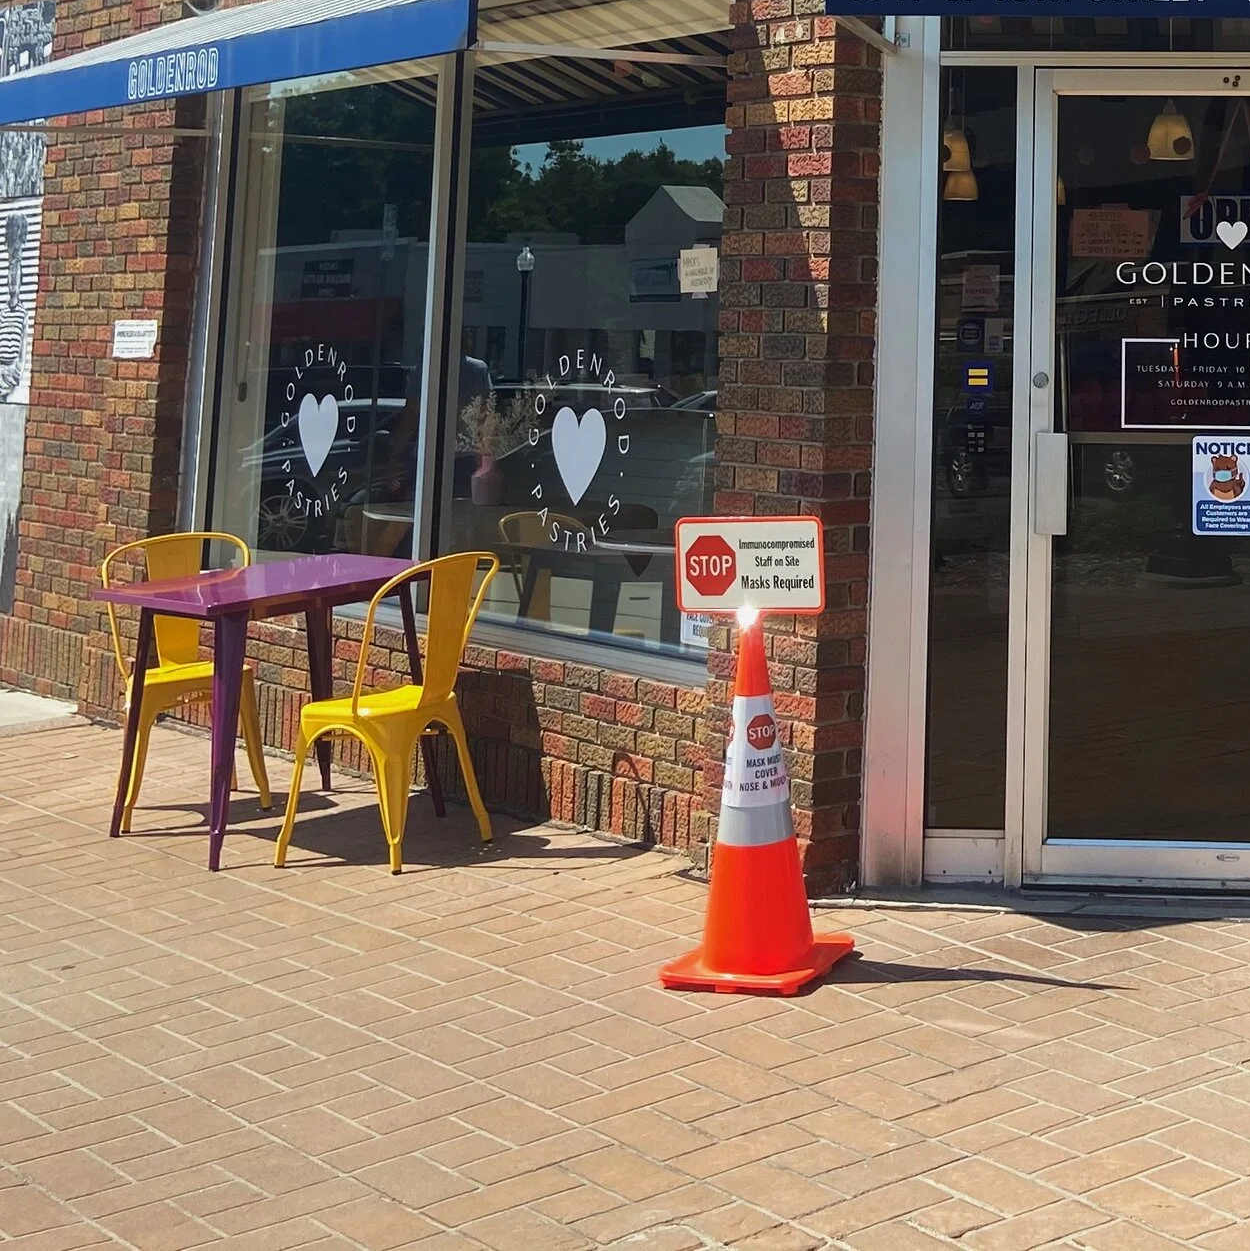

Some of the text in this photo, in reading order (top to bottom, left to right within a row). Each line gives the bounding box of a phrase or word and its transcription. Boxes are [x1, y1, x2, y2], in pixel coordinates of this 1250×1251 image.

[128, 47, 219, 100] GOLDENROD
[1136, 365, 1180, 373] TUESDAY
[1235, 366, 1245, 374] 10
[281, 344, 356, 433] GOLDENROD
[1158, 380, 1210, 388] SATURDAY
[528, 349, 629, 454] GOLDENROD
[282, 460, 348, 517] PASTRIES
[532, 484, 620, 552] PASTRIES
[739, 538, 815, 550] Immunocompromised
[690, 555, 732, 576] STOP
[755, 555, 800, 567] Staff on Site
[741, 575, 814, 591] Masks Required
[749, 725, 775, 740] STOP
[747, 758, 766, 768] MASK
[755, 767, 778, 779] COVER
[739, 781, 760, 791] NOSE
[763, 781, 768, 790] &
